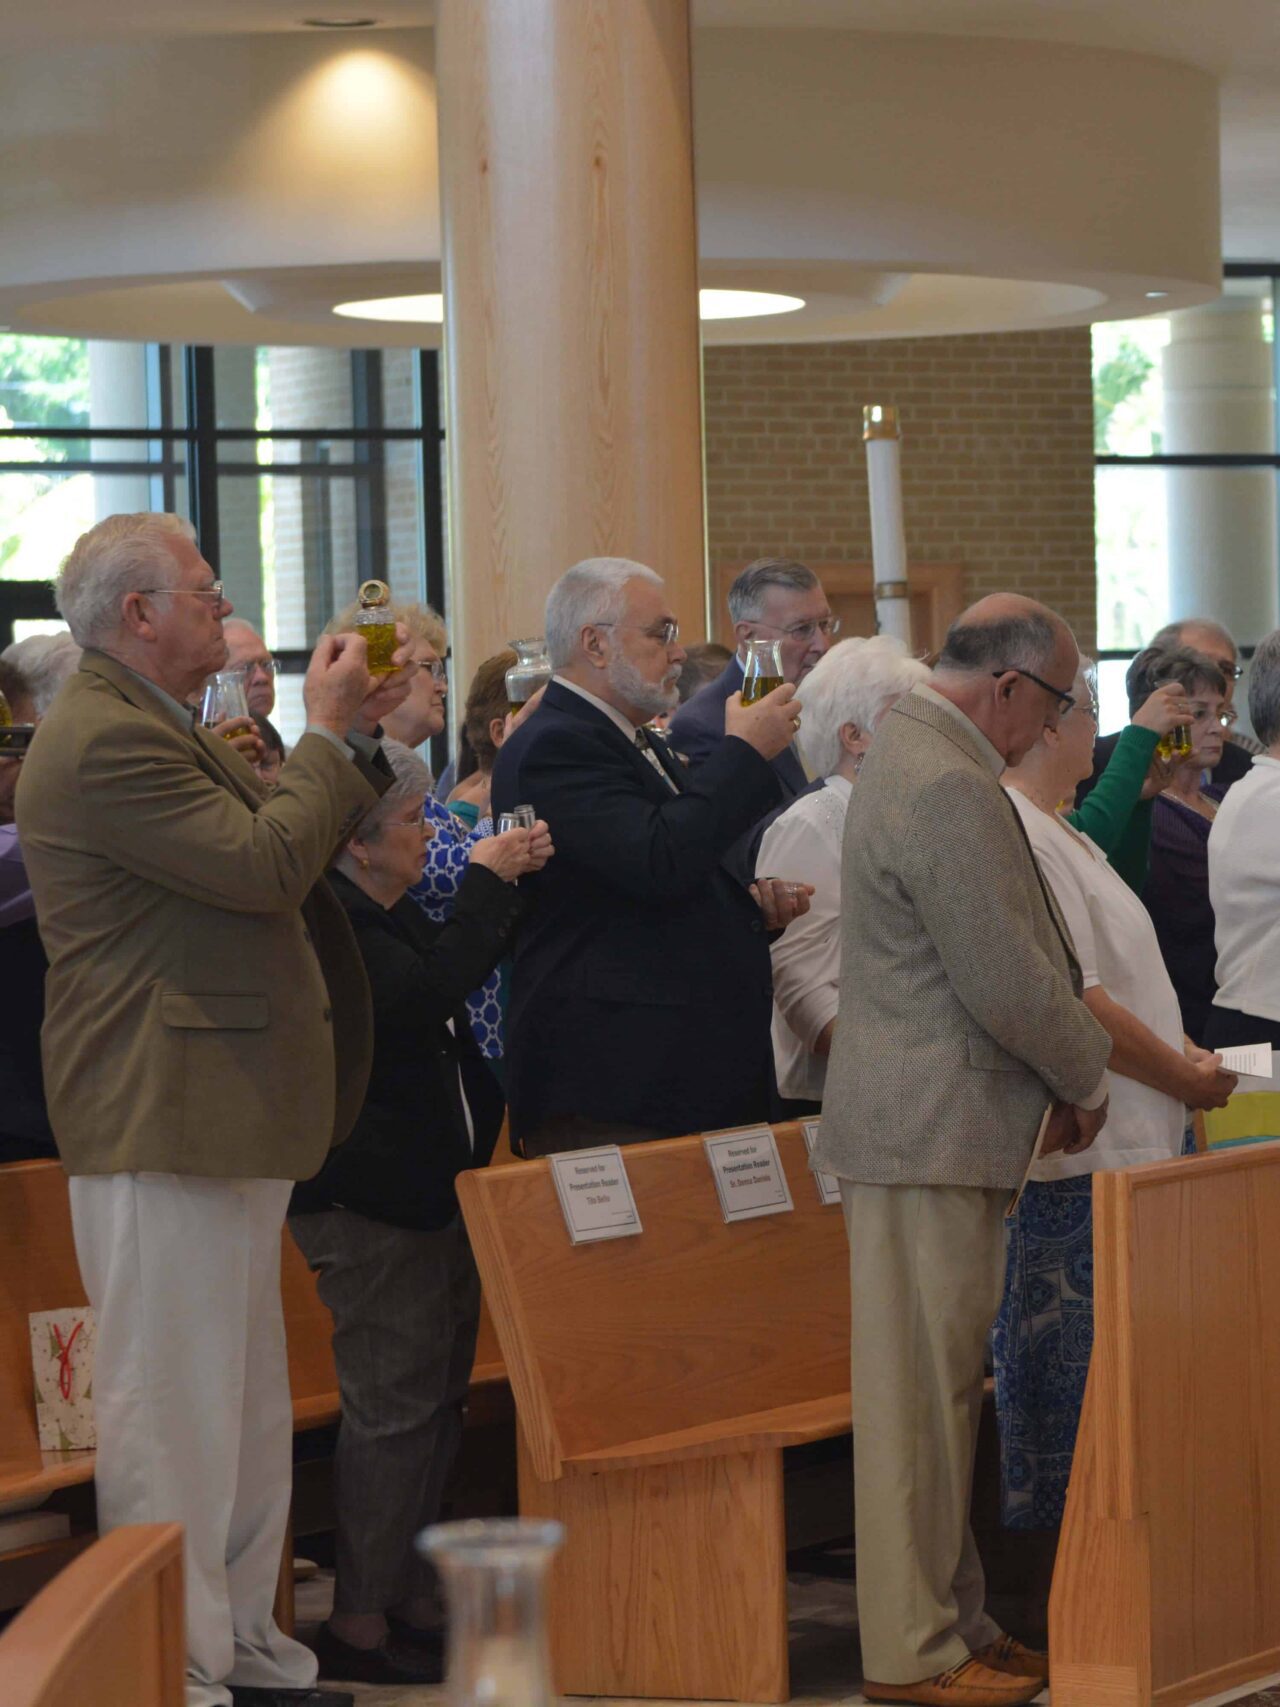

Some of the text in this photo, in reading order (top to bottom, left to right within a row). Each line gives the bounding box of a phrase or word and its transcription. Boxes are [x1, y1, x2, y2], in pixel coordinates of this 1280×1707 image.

[723, 1160, 770, 1174] Presentation Reader
[569, 1179, 618, 1191] Presentation Reader
